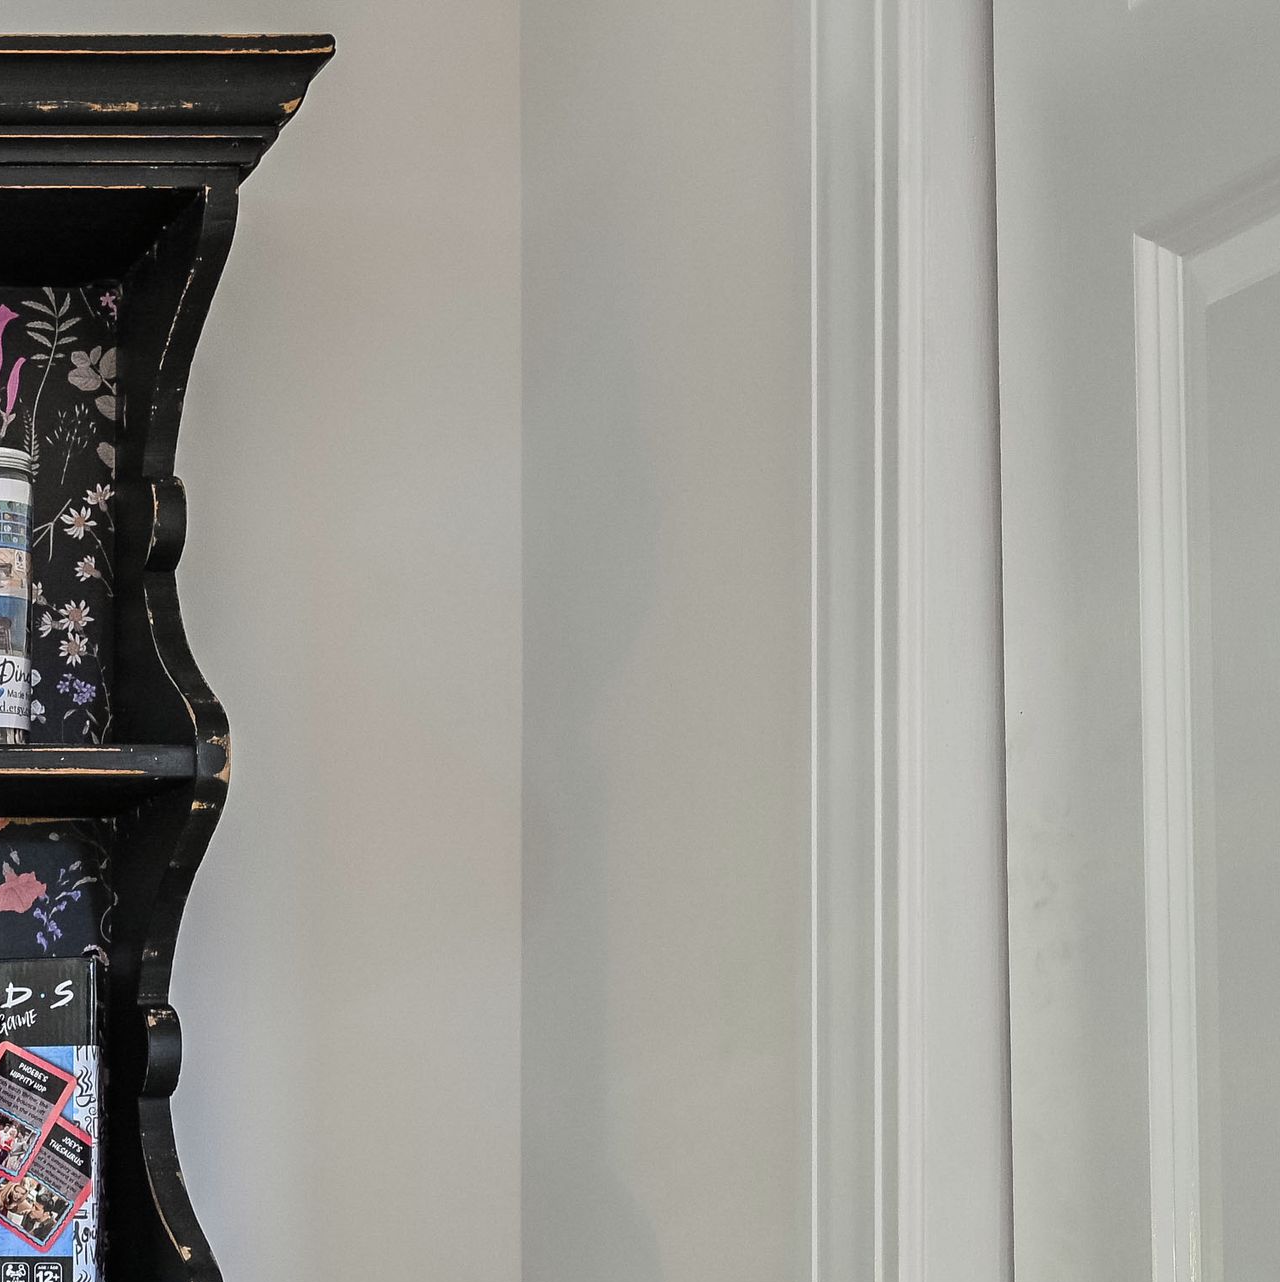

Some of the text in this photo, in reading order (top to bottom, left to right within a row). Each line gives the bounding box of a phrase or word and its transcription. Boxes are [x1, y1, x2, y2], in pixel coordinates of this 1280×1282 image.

[18, 1062, 48, 1082] PHOEBE'S
[49, 1139, 84, 1166] THESAURUS
[62, 1136, 83, 1153] JOEY'S
